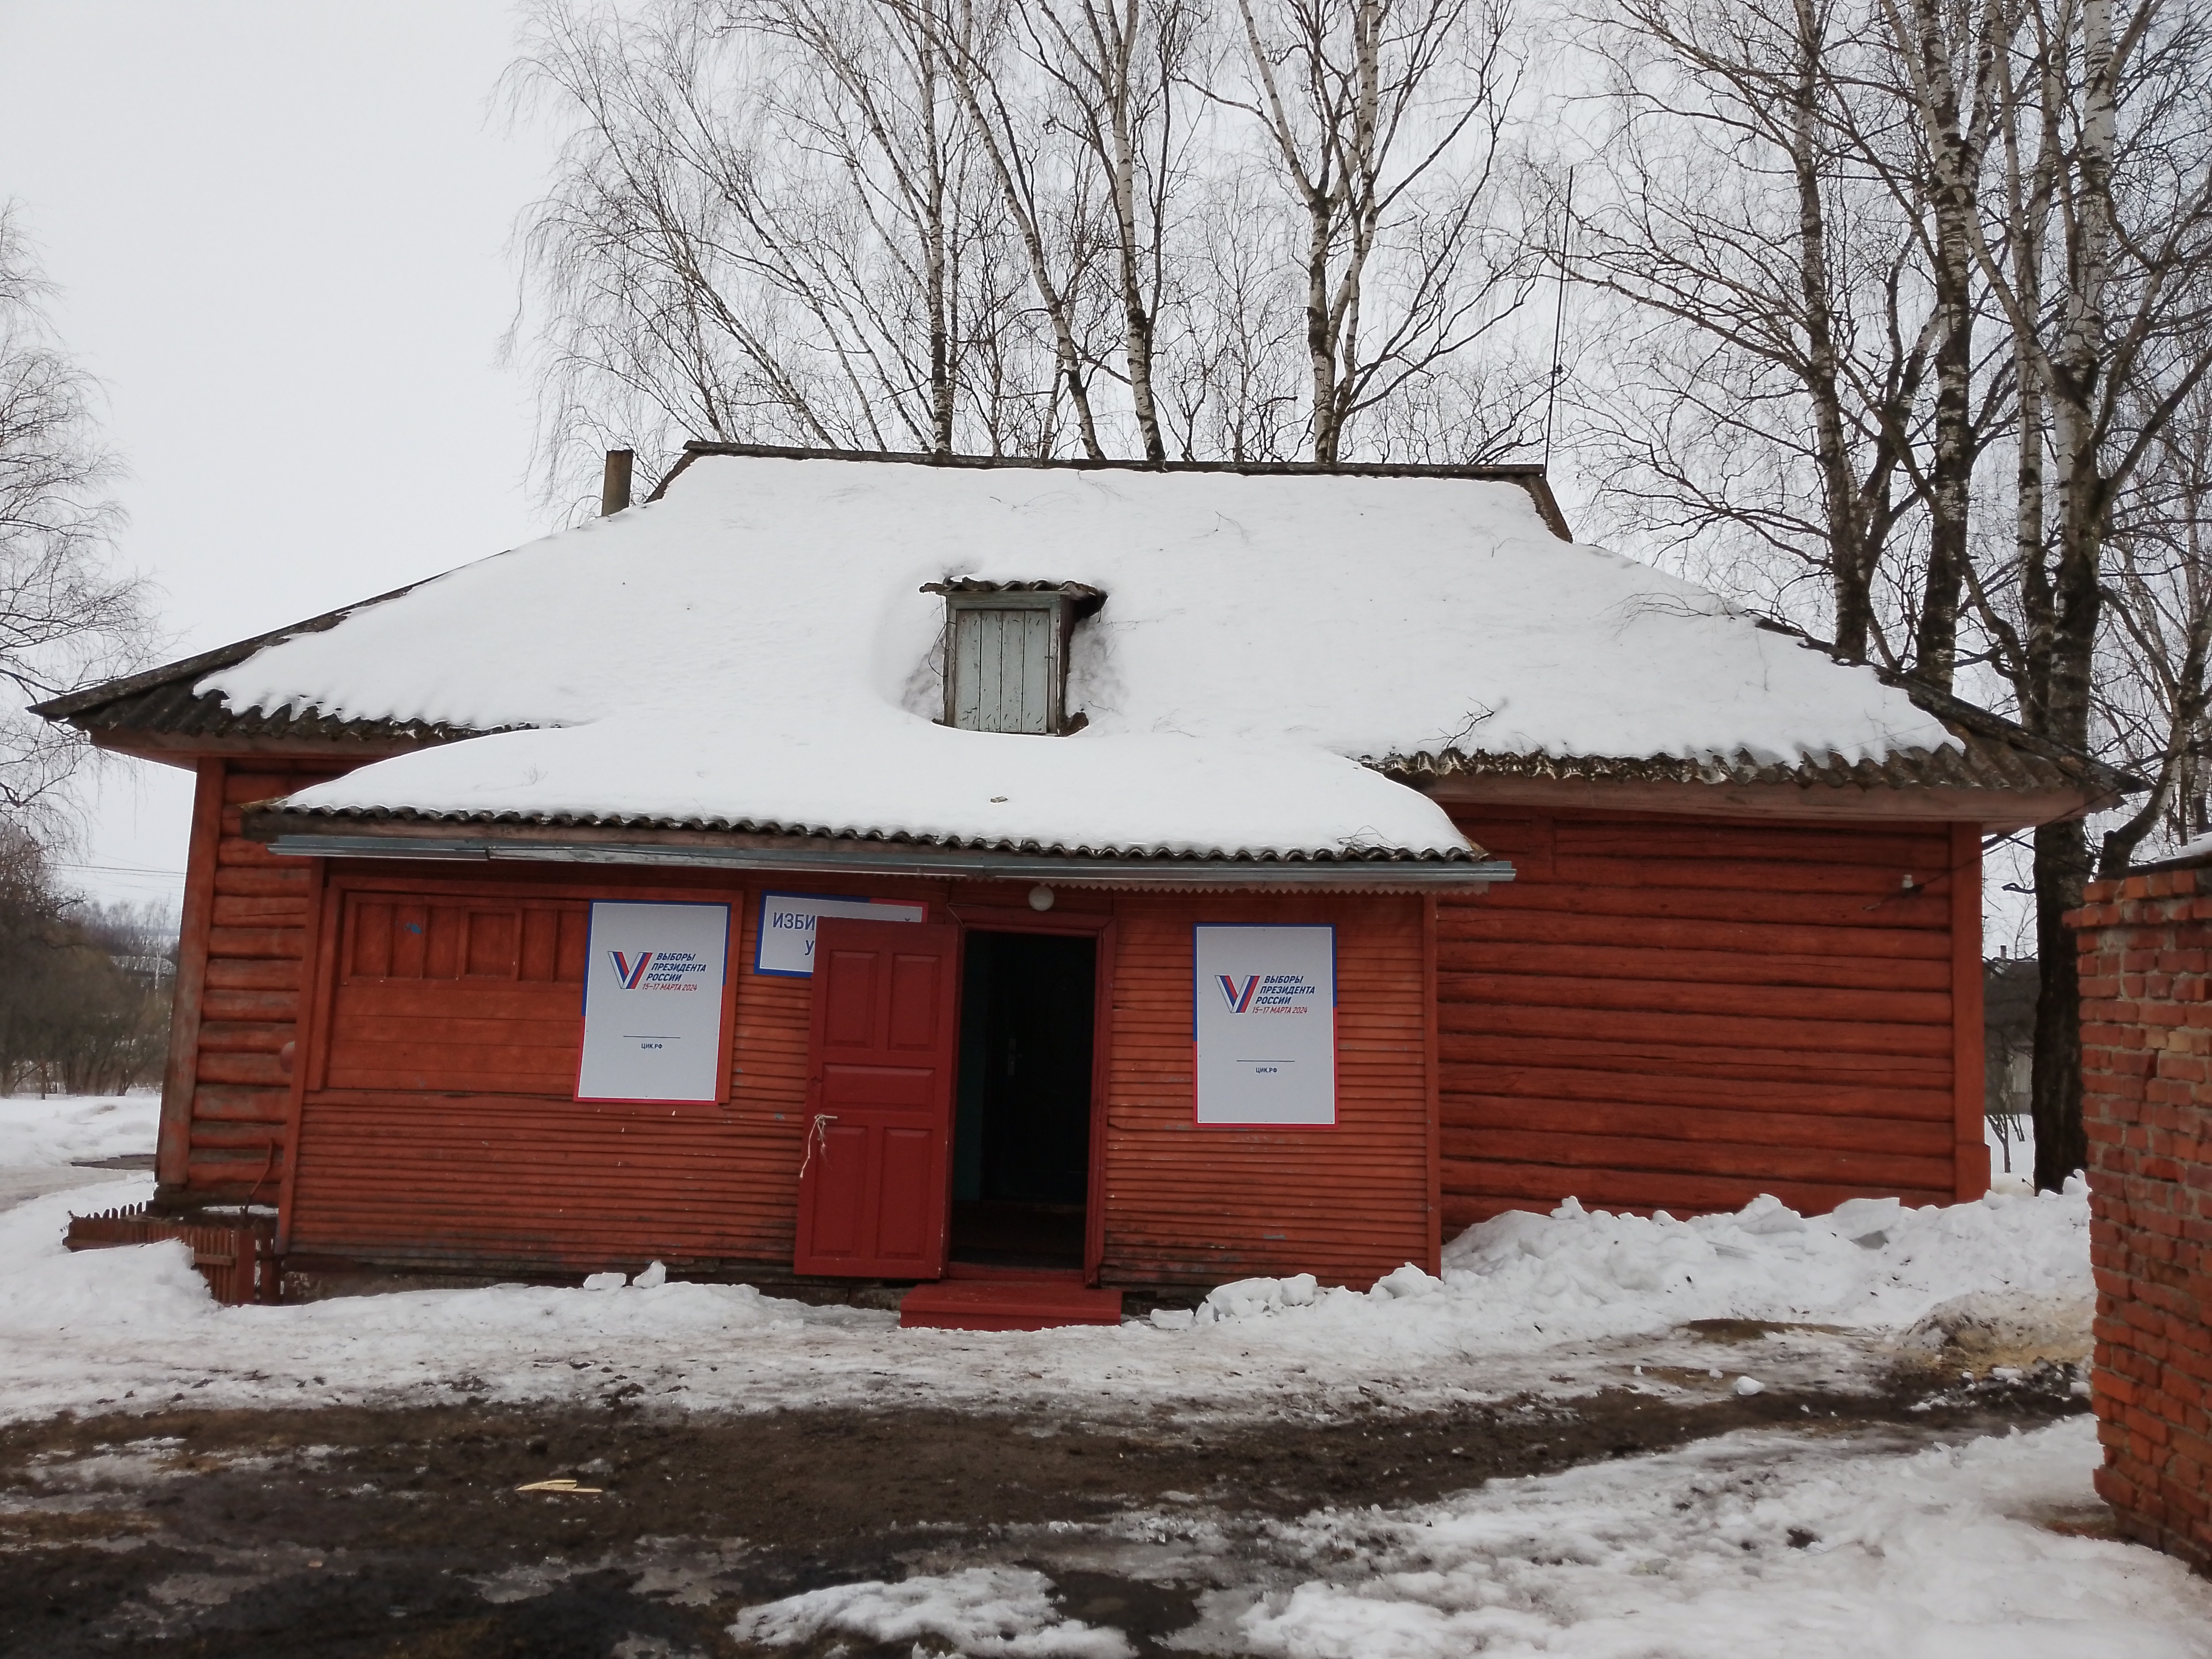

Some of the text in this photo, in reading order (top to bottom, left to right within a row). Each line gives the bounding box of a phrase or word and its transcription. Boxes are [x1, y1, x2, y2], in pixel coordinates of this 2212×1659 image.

[773, 912, 816, 931] ИЗБИ
[656, 952, 696, 961] ВЫБОРЫ
[651, 963, 706, 973] ПРЕЗИДЕНТА
[646, 974, 682, 982] РОССИИ
[1264, 975, 1304, 984] ВЫБОРЫ
[1260, 986, 1316, 995] ПРЕЗИДЕНТА
[1255, 996, 1292, 1005] РОССИИ
